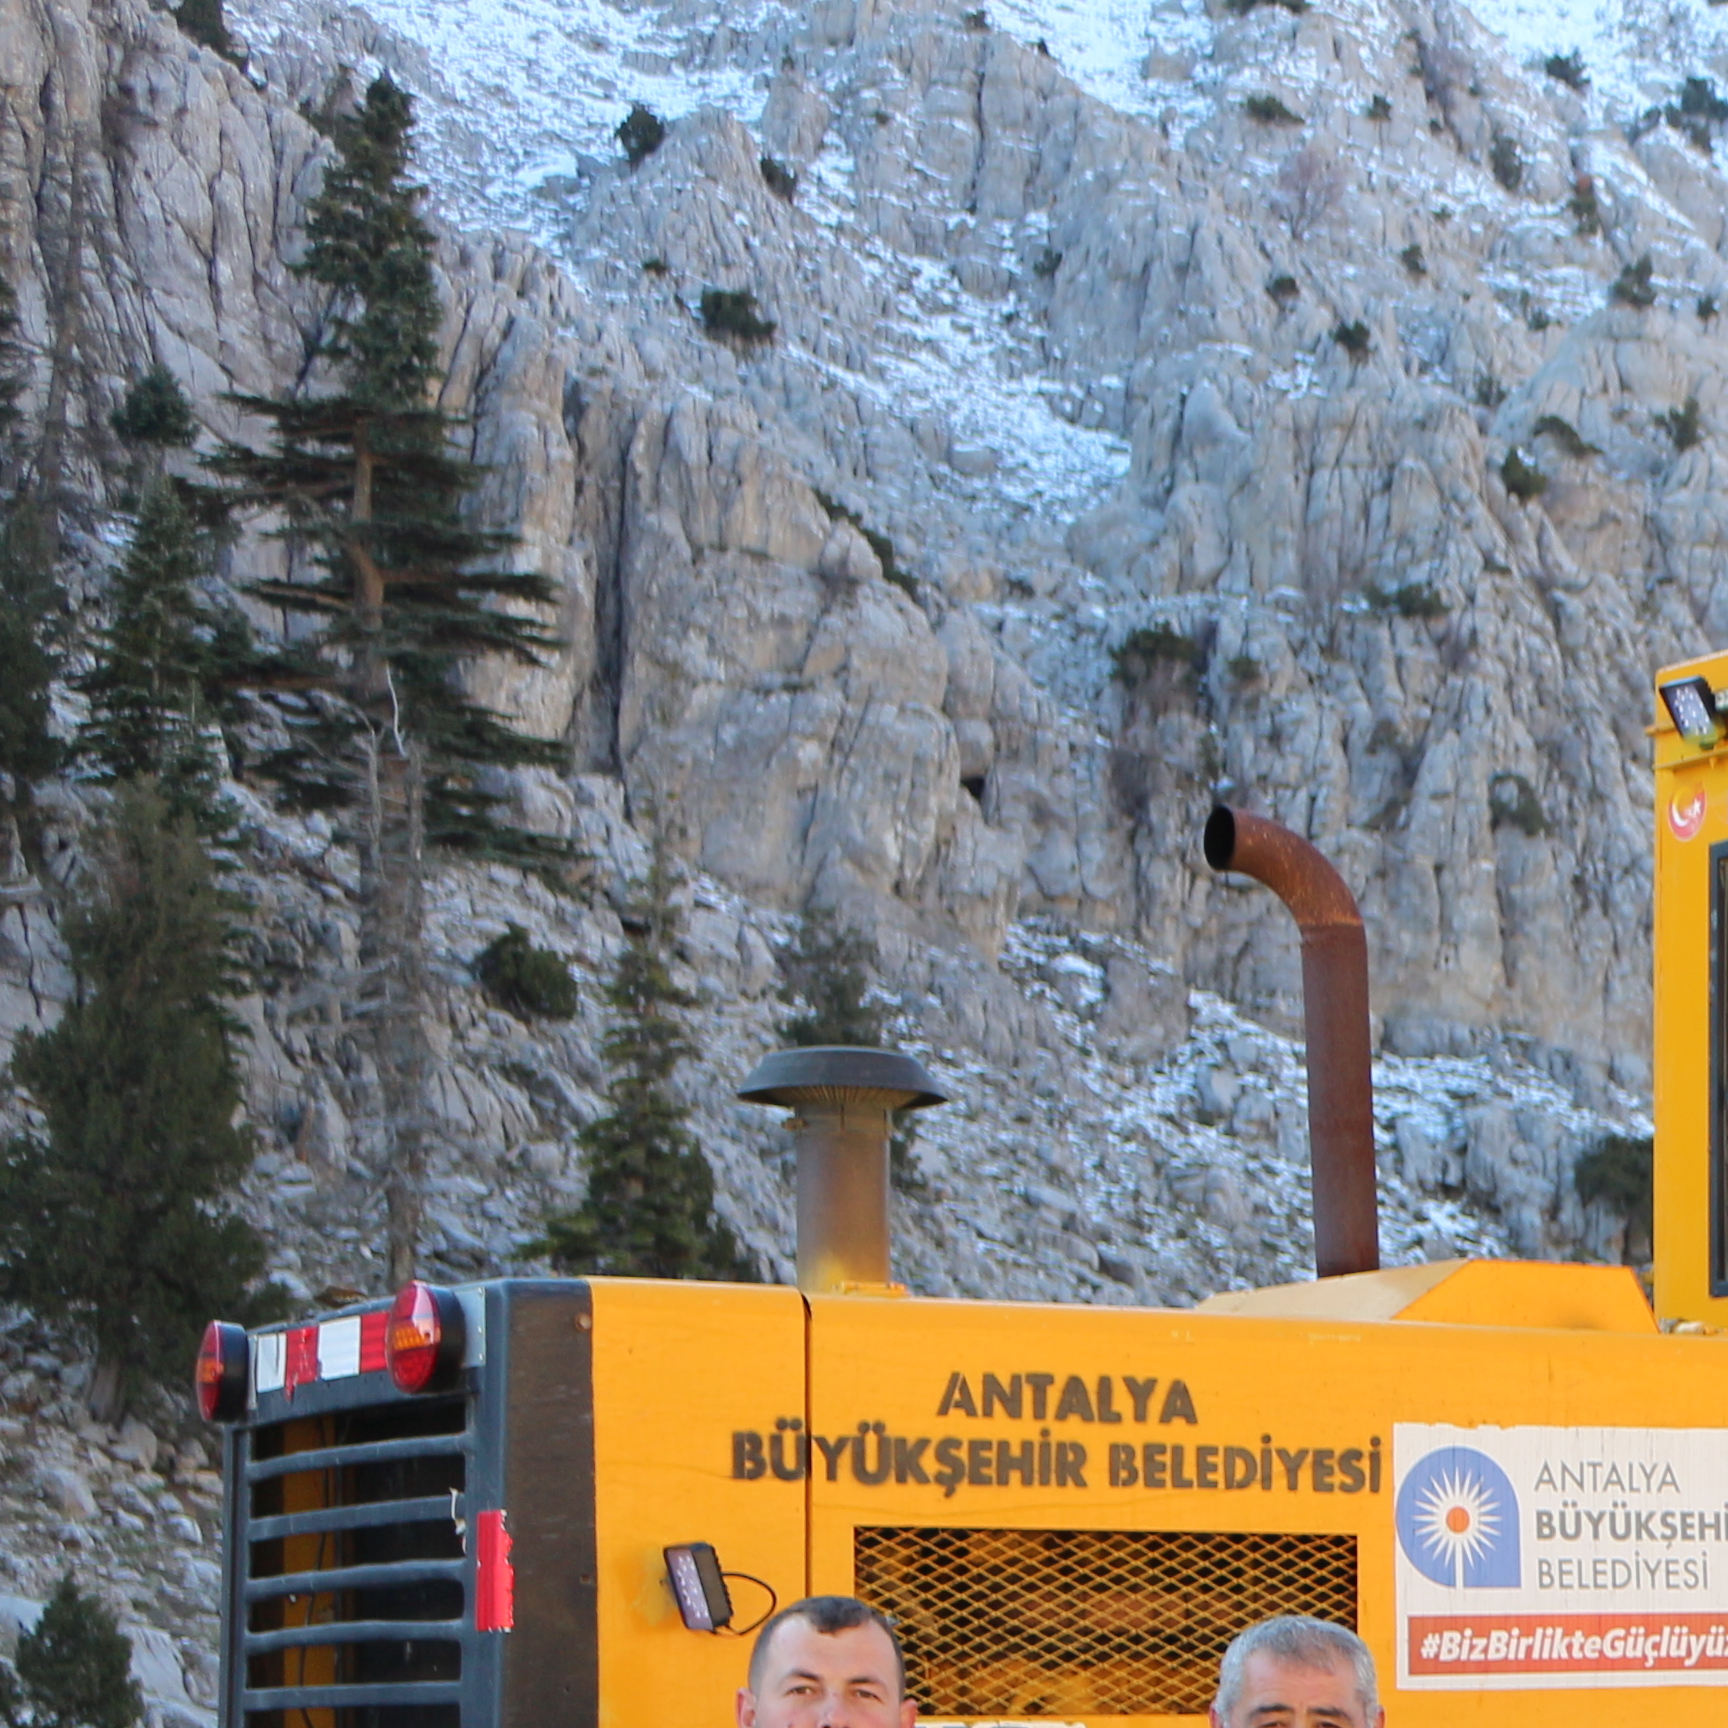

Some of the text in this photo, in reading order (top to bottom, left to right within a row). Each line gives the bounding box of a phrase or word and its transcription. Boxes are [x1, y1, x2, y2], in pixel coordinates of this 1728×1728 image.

[936, 1371, 1199, 1424] ANTALYA
[731, 1417, 1382, 1498] BÜYÜKŞEHİR BELEDİYESİ
[1534, 1459, 1681, 1494] ANTALYA
[1538, 1550, 1709, 1590] BELEDİYESİ
